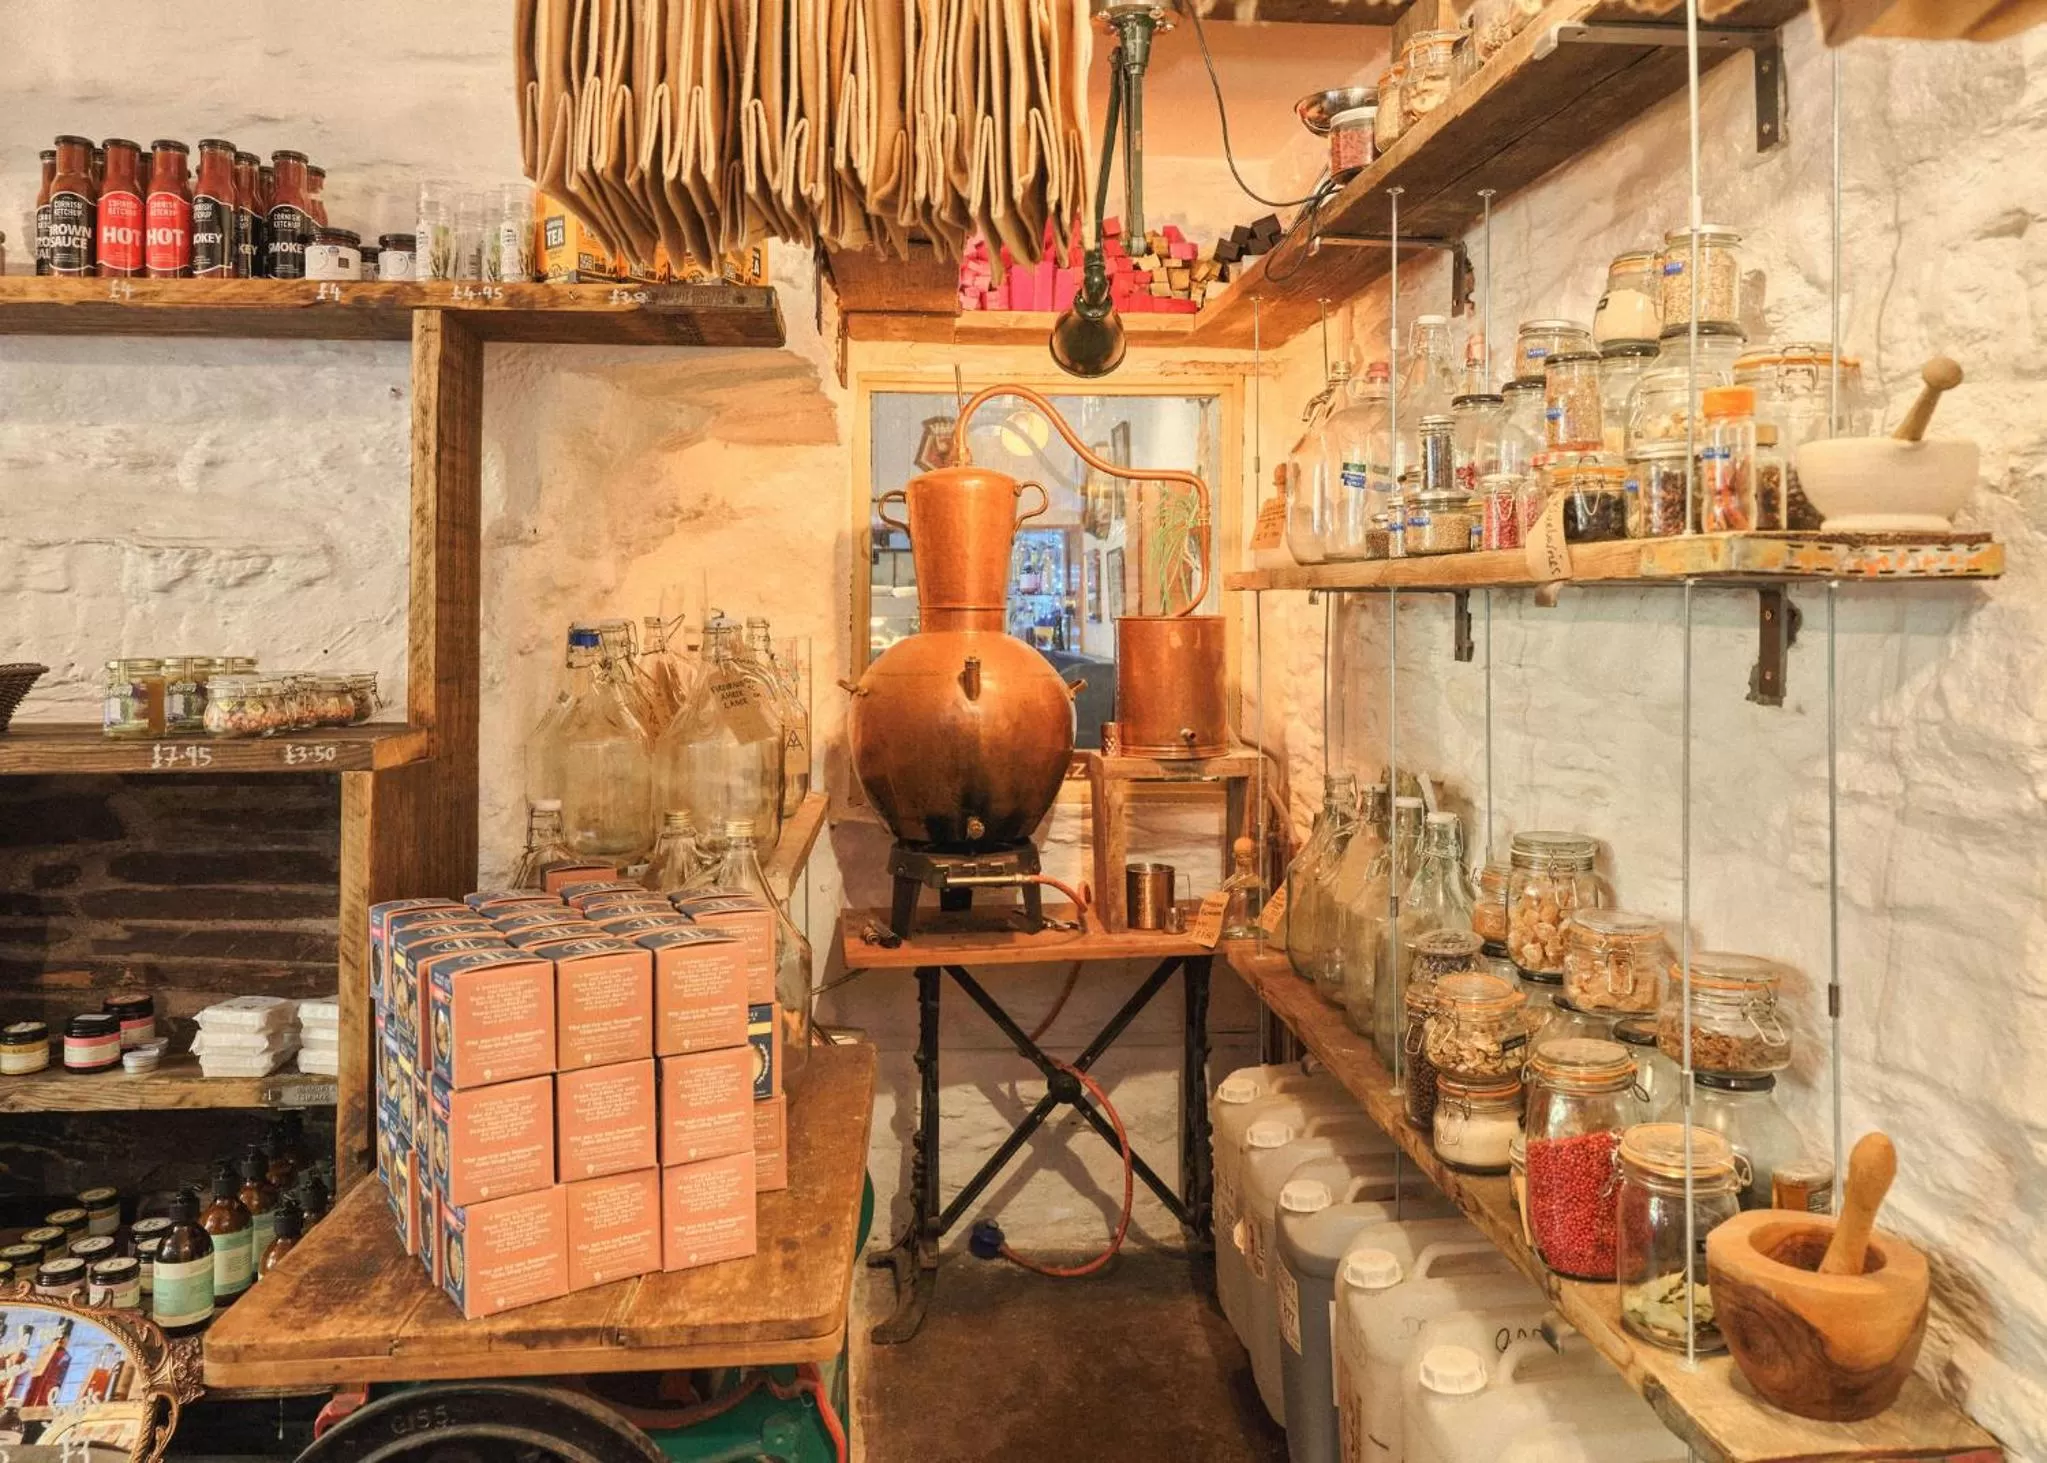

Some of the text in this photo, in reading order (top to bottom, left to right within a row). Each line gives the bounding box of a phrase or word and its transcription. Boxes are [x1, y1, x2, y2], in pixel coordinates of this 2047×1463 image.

[50, 235, 88, 250] SAUCE
[102, 226, 141, 247] HOT
[146, 227, 184, 248] HOT
[193, 232, 222, 245] OKEY
[546, 227, 564, 247] TEA
[268, 241, 305, 254] SMOKE
[316, 283, 341, 300] £4
[451, 284, 505, 300] £4.95
[151, 743, 212, 769] £7.95
[283, 743, 337, 765] £3.50
